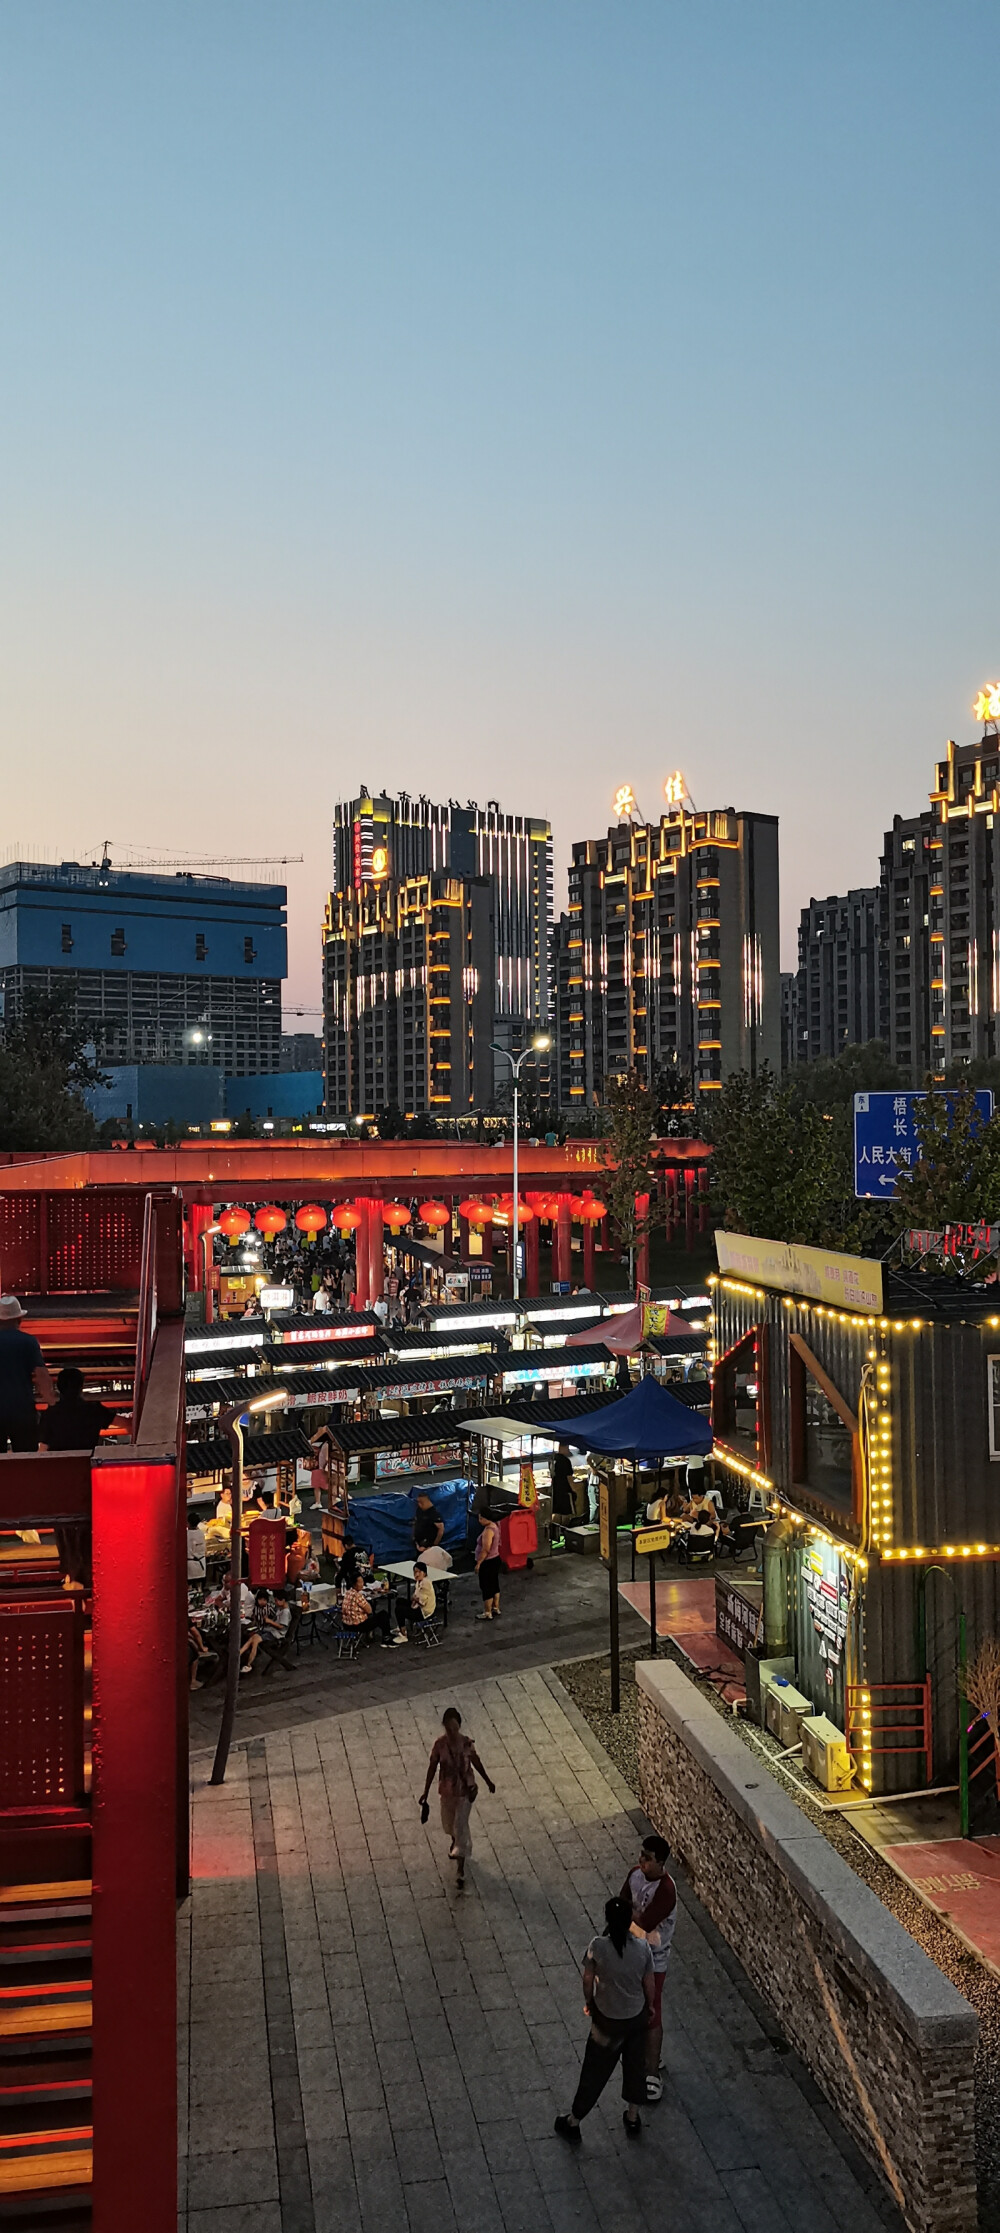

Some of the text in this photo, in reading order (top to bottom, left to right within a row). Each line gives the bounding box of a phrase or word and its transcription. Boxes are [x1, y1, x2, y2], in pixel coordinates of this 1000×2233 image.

[857, 1095, 866, 1104] 东
[859, 1145, 912, 1165] 人民大街
[307, 1389, 348, 1404] 脆皮鲜奶
